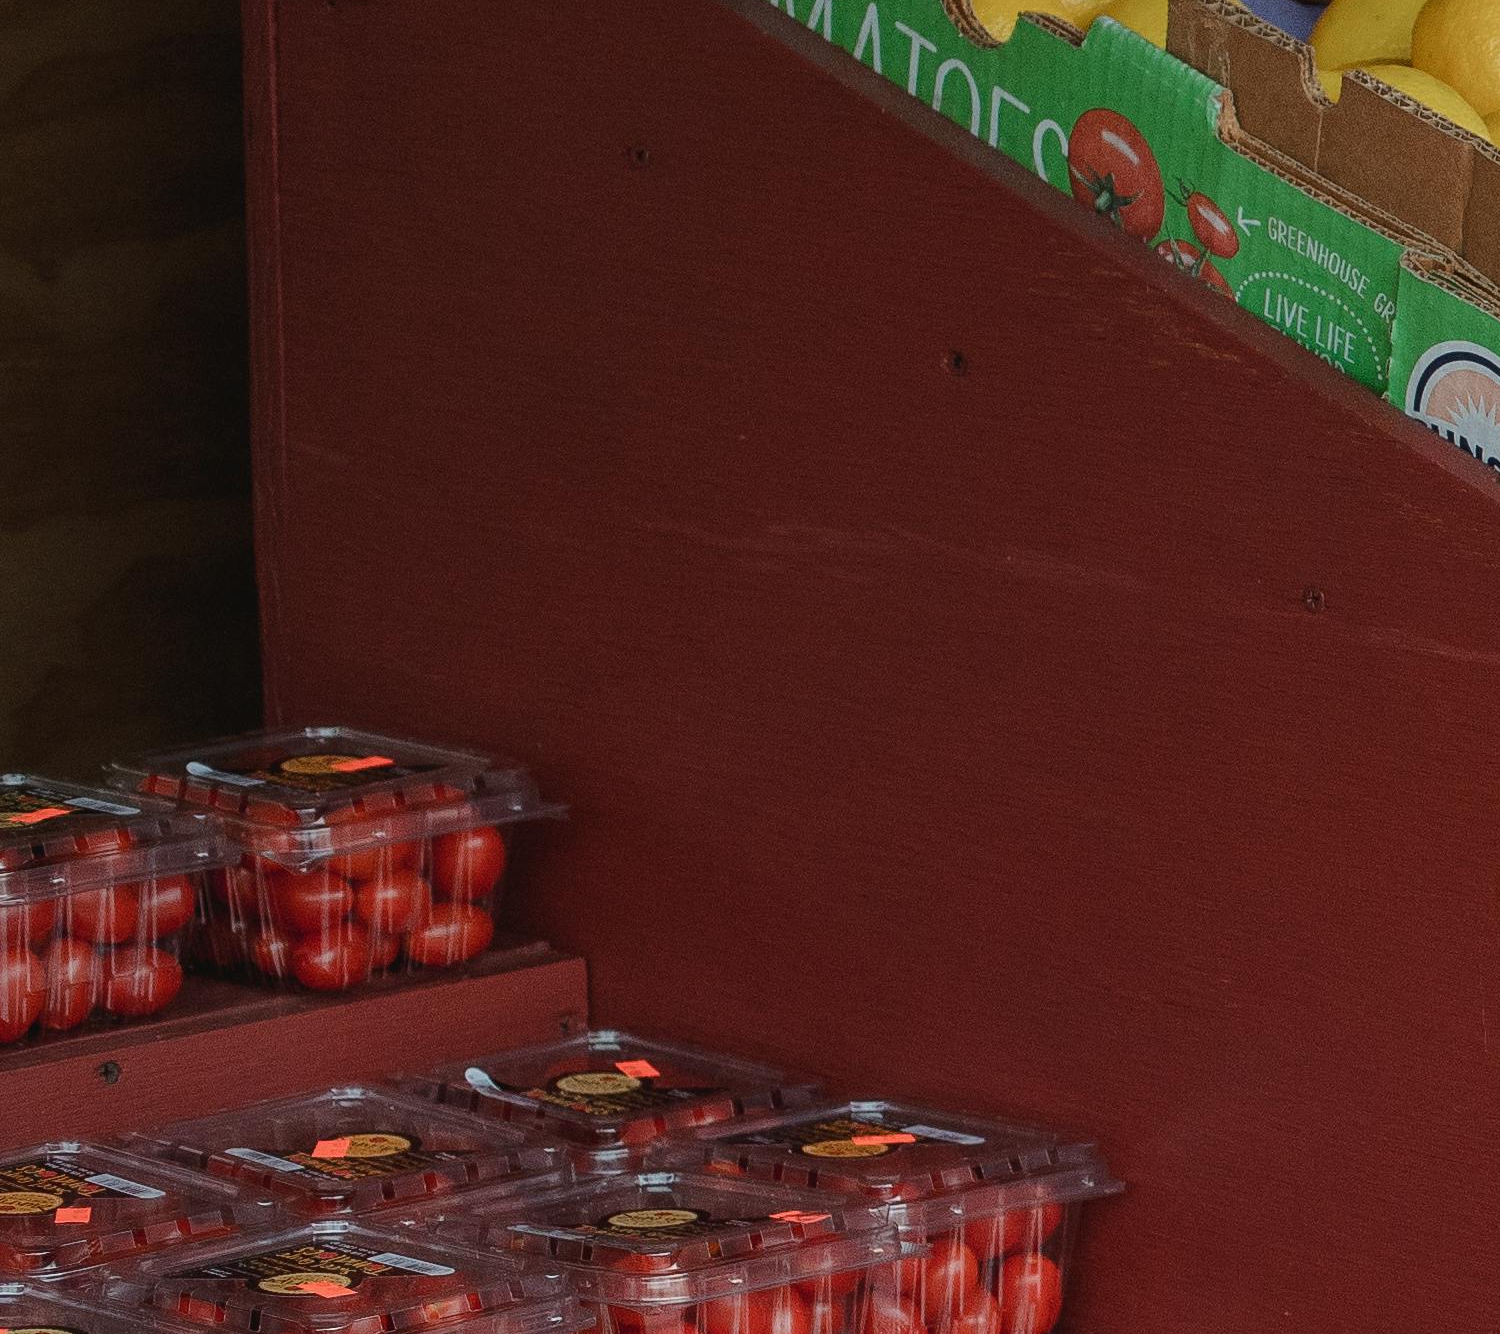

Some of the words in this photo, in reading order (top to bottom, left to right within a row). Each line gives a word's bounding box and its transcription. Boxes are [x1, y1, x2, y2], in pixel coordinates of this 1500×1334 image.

[1267, 216, 1371, 299] GREENHOUSE
[1263, 287, 1309, 338] LIVE
[1315, 315, 1357, 365] LIFE
